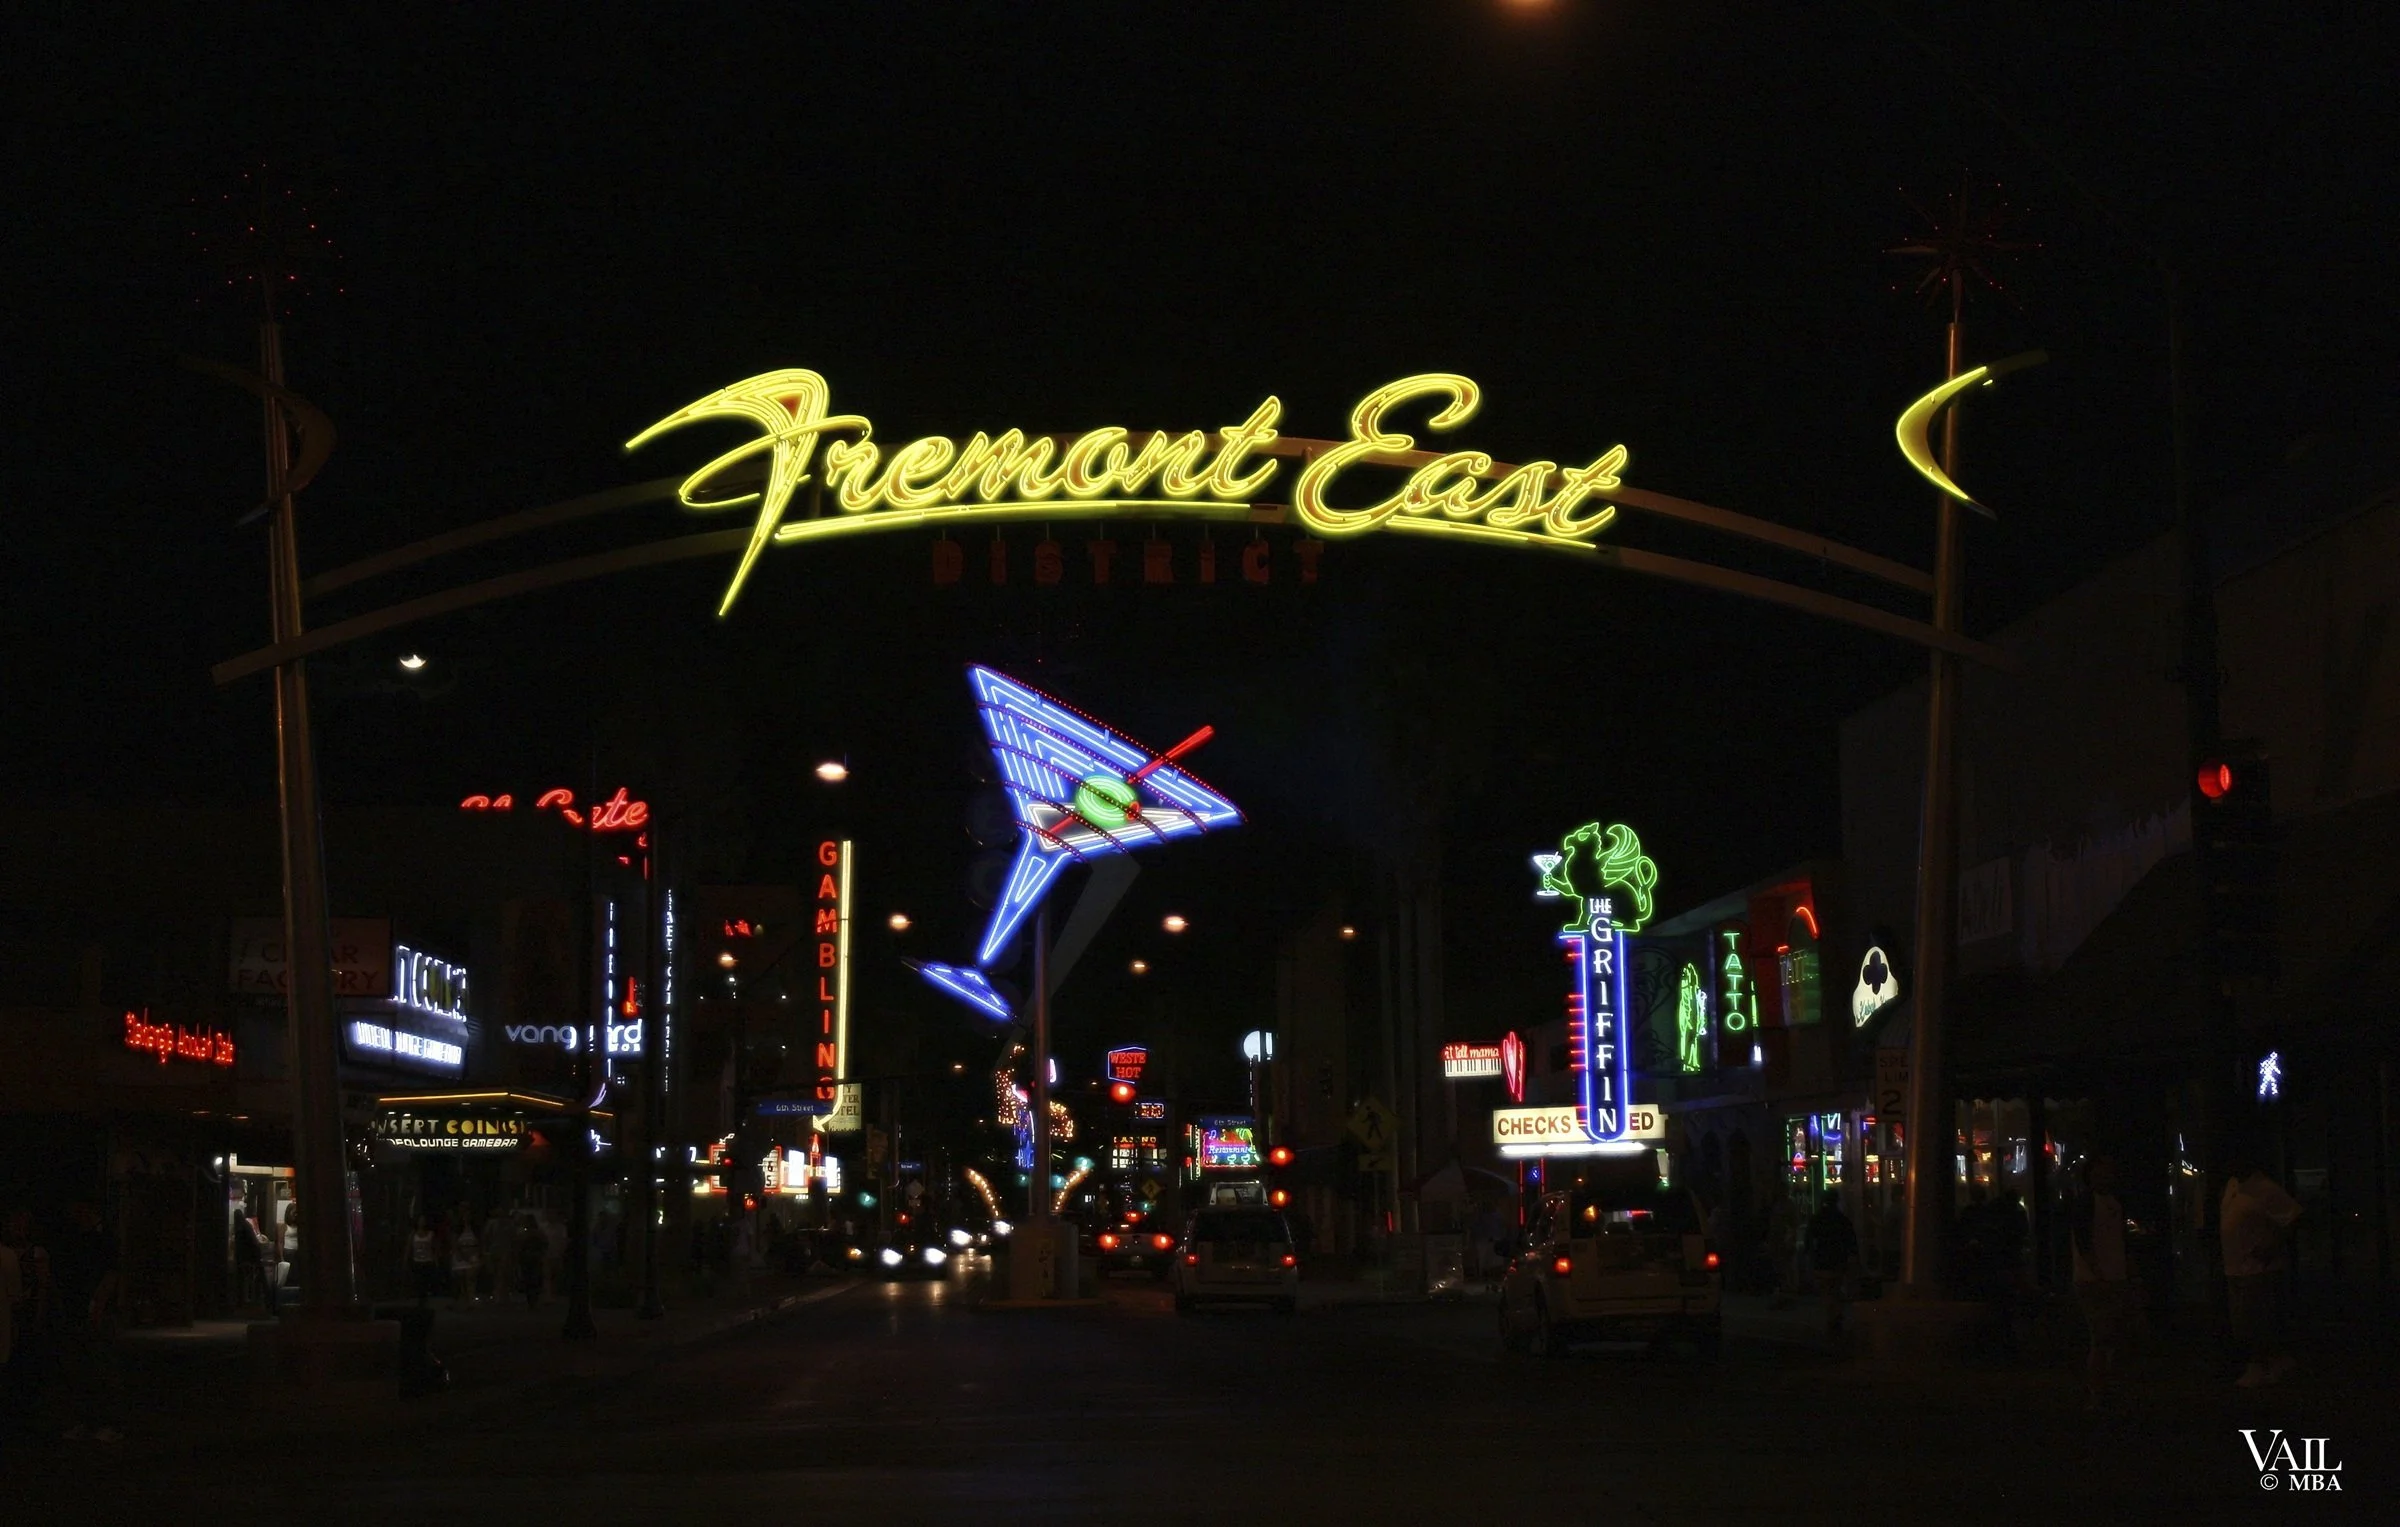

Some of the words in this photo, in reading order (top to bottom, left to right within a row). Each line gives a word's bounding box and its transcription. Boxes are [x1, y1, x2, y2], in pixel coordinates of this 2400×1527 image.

[625, 368, 1280, 617] Fremont
[1297, 375, 1627, 536] East
[931, 539, 1325, 585] DISTRICT
[1590, 898, 1612, 914] THE
[817, 841, 838, 1100] GAMBLING
[1591, 917, 1617, 1133] GRIFFIN
[1110, 1052, 1146, 1063] WESTE
[1470, 1048, 1500, 1059] mama
[1116, 1067, 1141, 1078] HOT
[1881, 1090, 1902, 1114] 2
[1497, 1115, 1571, 1136] CHECKS
[462, 1138, 518, 1148] GAMEBAR
